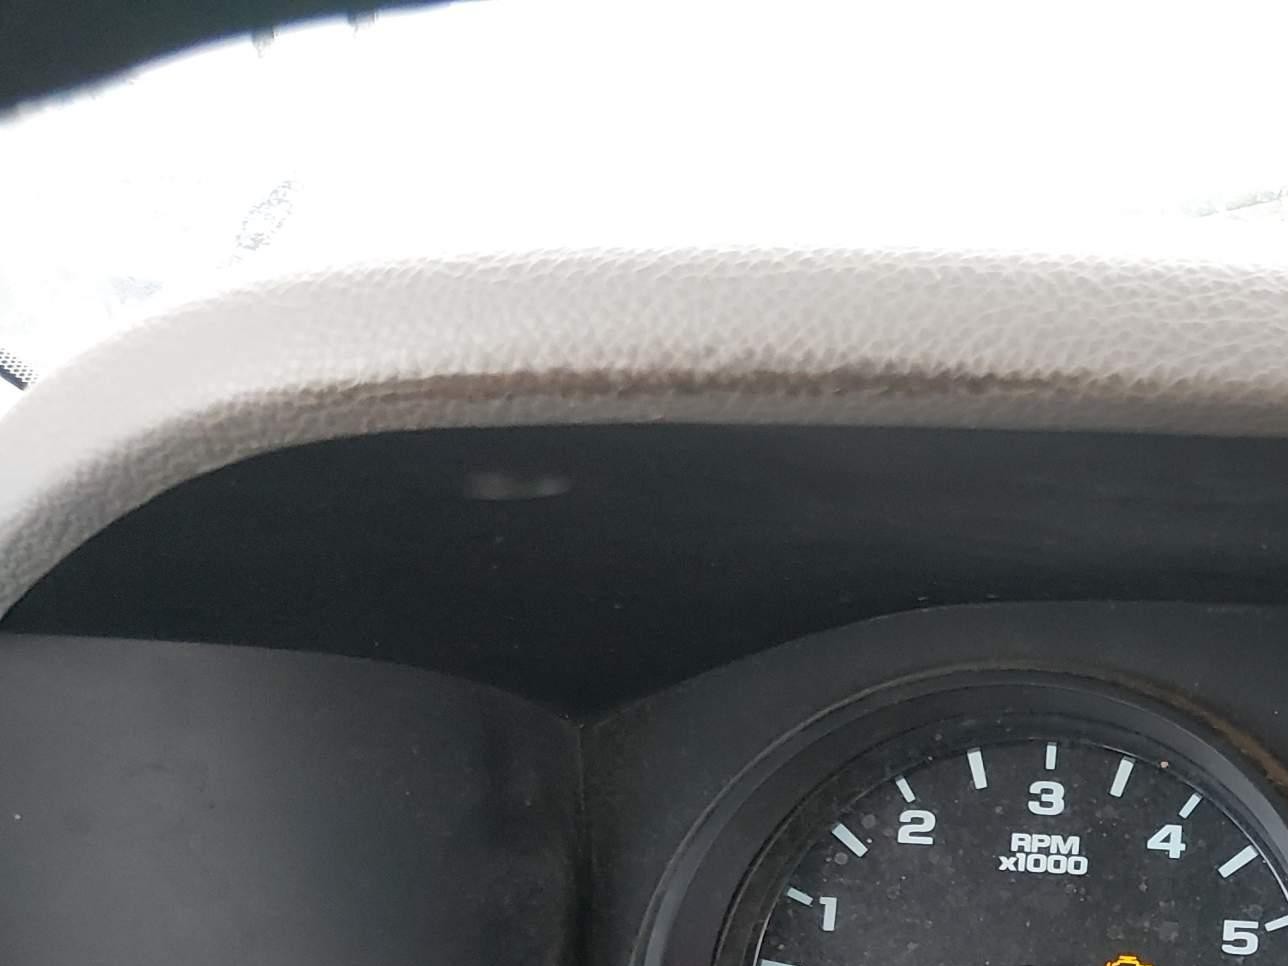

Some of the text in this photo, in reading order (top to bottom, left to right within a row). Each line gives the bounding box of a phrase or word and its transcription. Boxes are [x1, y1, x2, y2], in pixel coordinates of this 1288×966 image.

[1028, 780, 1065, 816] 3
[898, 810, 936, 845] 2
[1010, 833, 1080, 855] RPM
[1146, 824, 1186, 859] 4
[998, 855, 1089, 876] x1000
[819, 896, 837, 931] 1
[1221, 920, 1259, 955] 5
